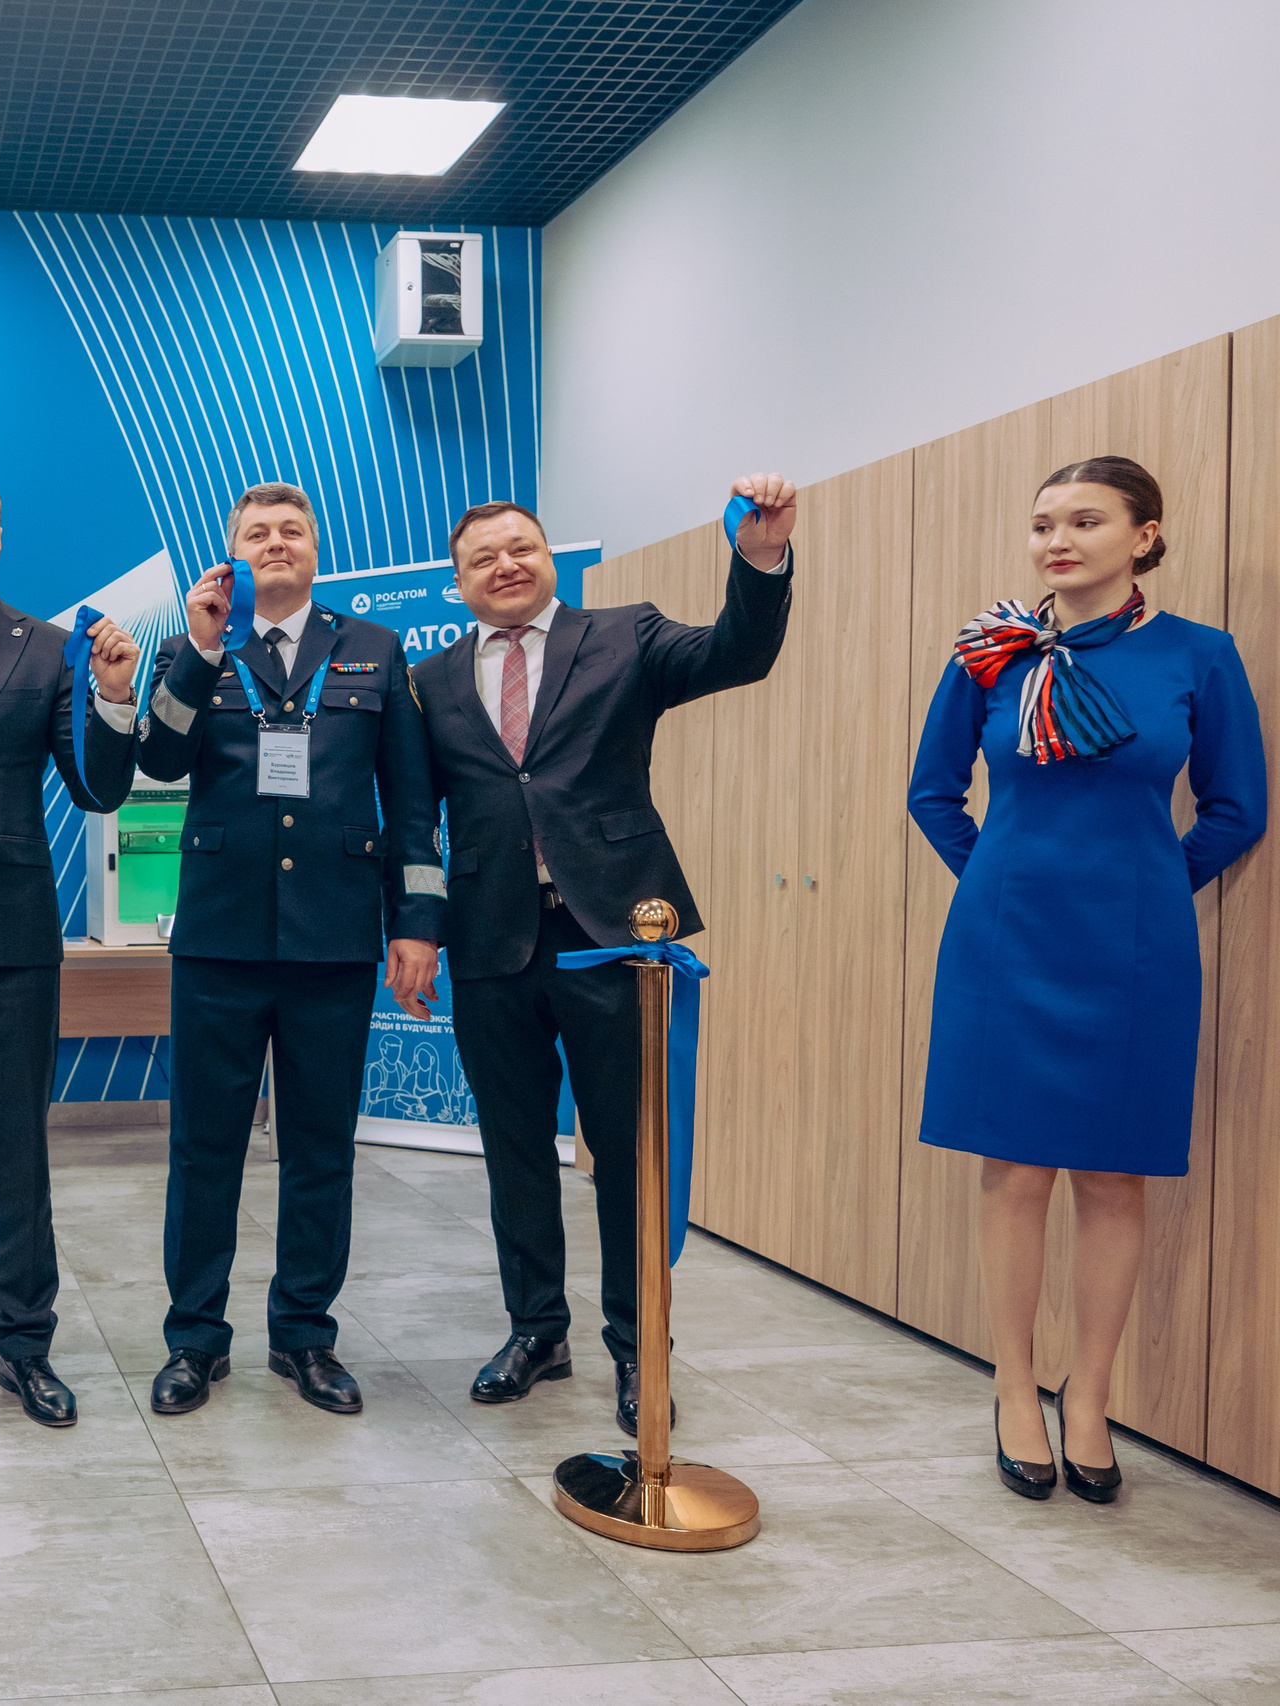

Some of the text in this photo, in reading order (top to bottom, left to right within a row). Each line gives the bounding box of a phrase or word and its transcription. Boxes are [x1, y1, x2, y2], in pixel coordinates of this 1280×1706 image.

[375, 588, 427, 603] РОСАТОМ
[395, 1023, 401, 1031] В
[402, 1023, 442, 1033] БУДУЩЕЕ
